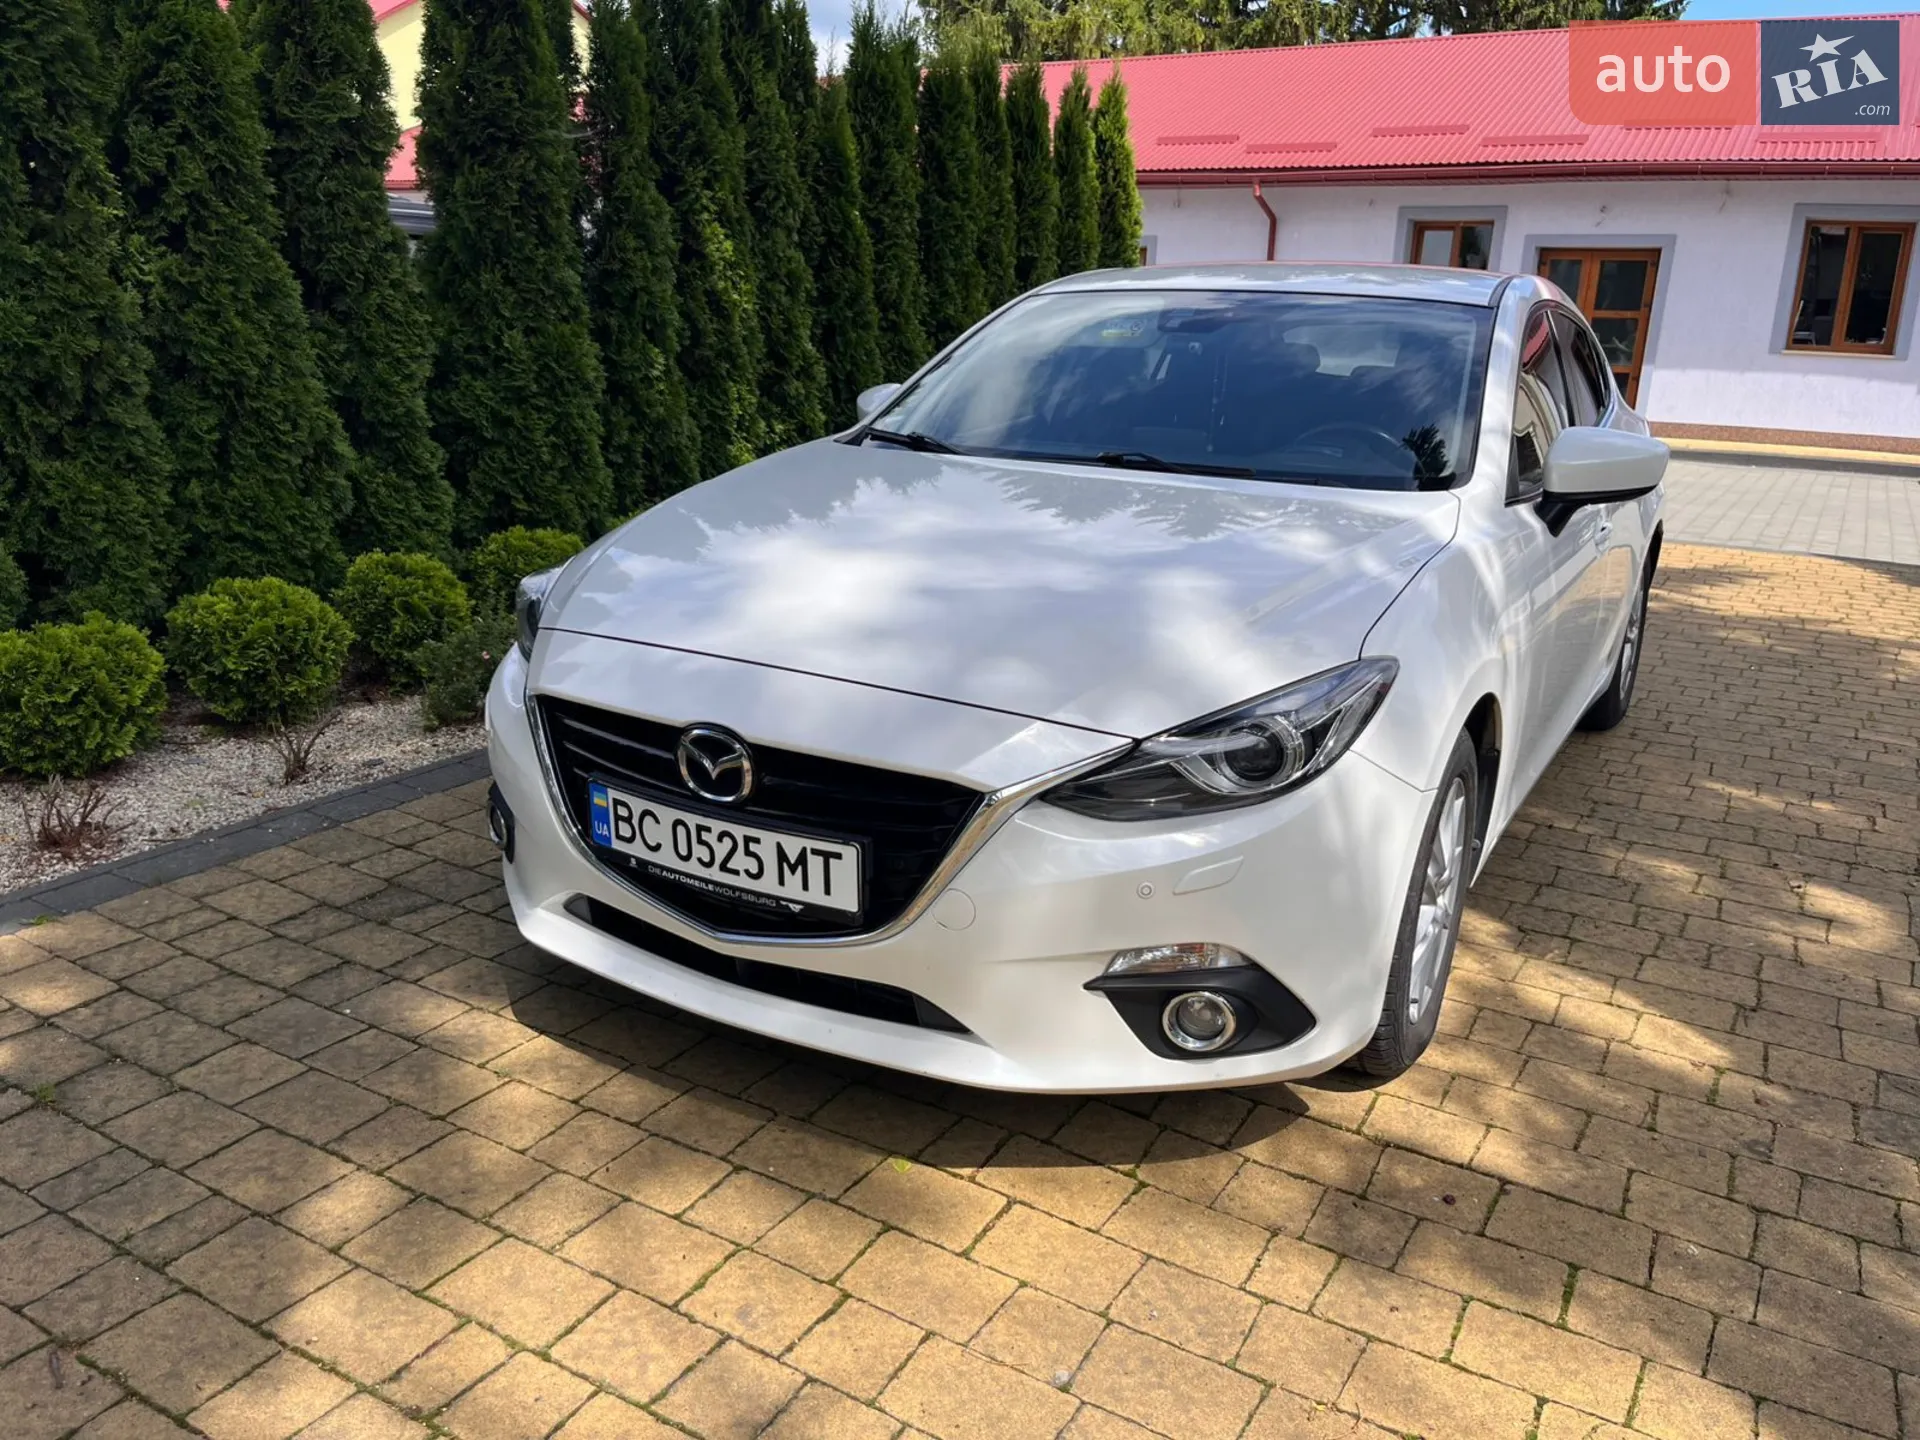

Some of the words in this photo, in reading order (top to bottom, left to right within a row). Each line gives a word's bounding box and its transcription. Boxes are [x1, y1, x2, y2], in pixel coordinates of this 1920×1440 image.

[594, 820, 609, 838] UA
[612, 797, 662, 852] BC
[671, 818, 765, 881] 0525
[775, 841, 843, 897] MT
